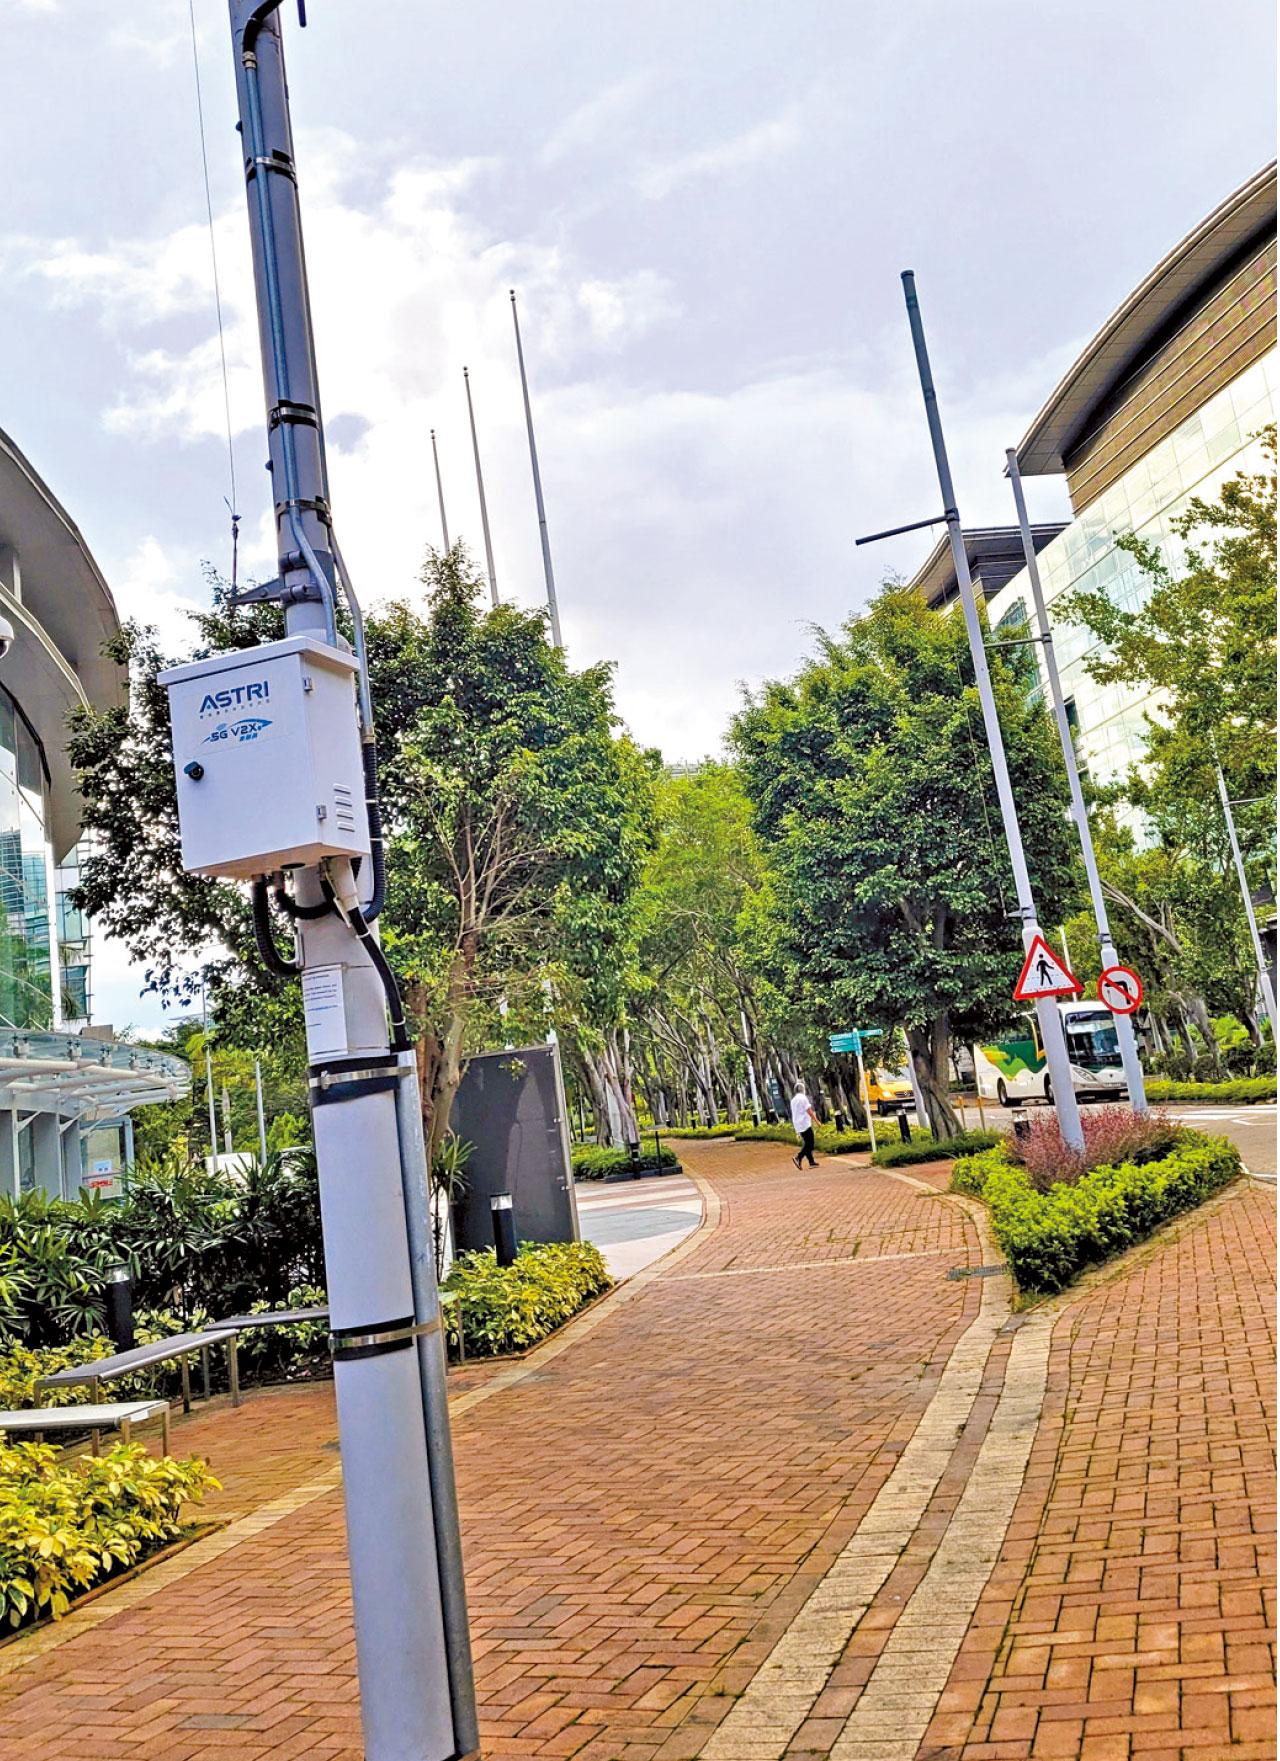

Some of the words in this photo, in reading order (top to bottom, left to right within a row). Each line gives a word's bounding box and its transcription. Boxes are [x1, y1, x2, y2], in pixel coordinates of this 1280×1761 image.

[200, 680, 269, 713] ASTRI
[210, 730, 228, 742] 5G
[230, 723, 258, 737] V2X
